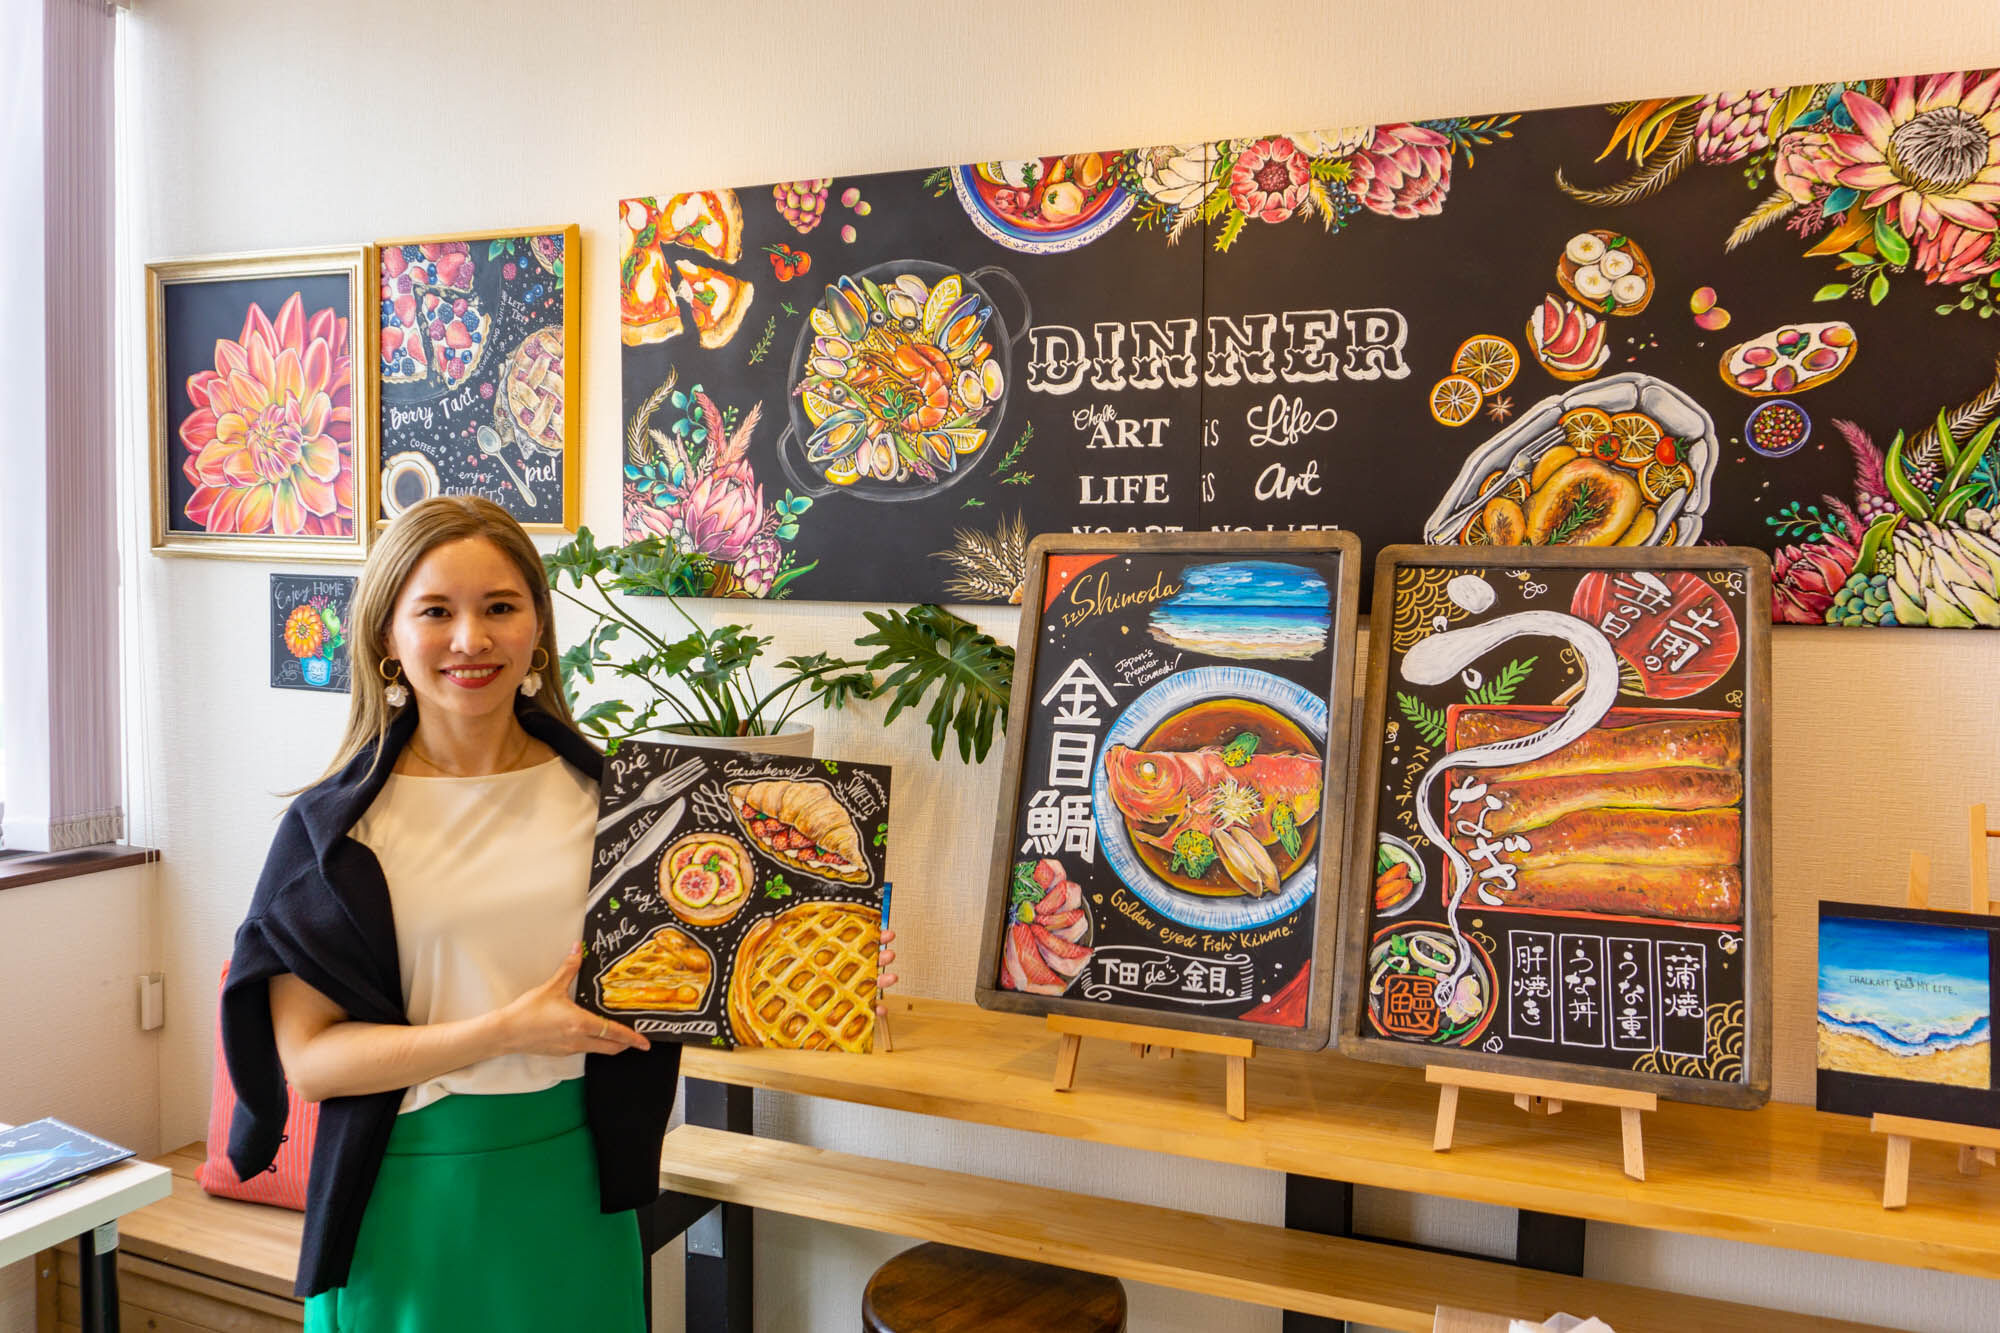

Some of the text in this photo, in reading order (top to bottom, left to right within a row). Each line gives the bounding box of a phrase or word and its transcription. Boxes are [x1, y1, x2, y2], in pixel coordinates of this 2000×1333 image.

[1027, 308, 1411, 395] DINNER
[390, 406, 433, 430] Berry
[1073, 394, 1338, 449] Chalk ART is Life
[524, 457, 557, 489] pie!
[1079, 460, 1321, 504] LIFE is Art
[274, 581, 344, 609] Enjoy HOME
[1070, 570, 1182, 627] Shimoda
[610, 753, 650, 784] Pie
[723, 759, 816, 783] Strawberry
[1021, 658, 1118, 864] 金目鯛
[844, 776, 880, 816] SWEETS
[1395, 745, 1431, 849] スタミナアップ
[623, 886, 657, 913] Fig
[1110, 888, 1156, 930] Golden
[1159, 927, 1198, 948] eyed
[1201, 934, 1234, 952] Fish
[591, 917, 640, 955] Apple
[1098, 958, 1139, 986] 下田
[1514, 945, 1551, 1026] 肝焼き
[1565, 949, 1599, 1028] うな丼
[1616, 951, 1648, 1039] うな重
[1664, 954, 1704, 1018] 蒲焼
[1389, 977, 1438, 1032] 鰻
